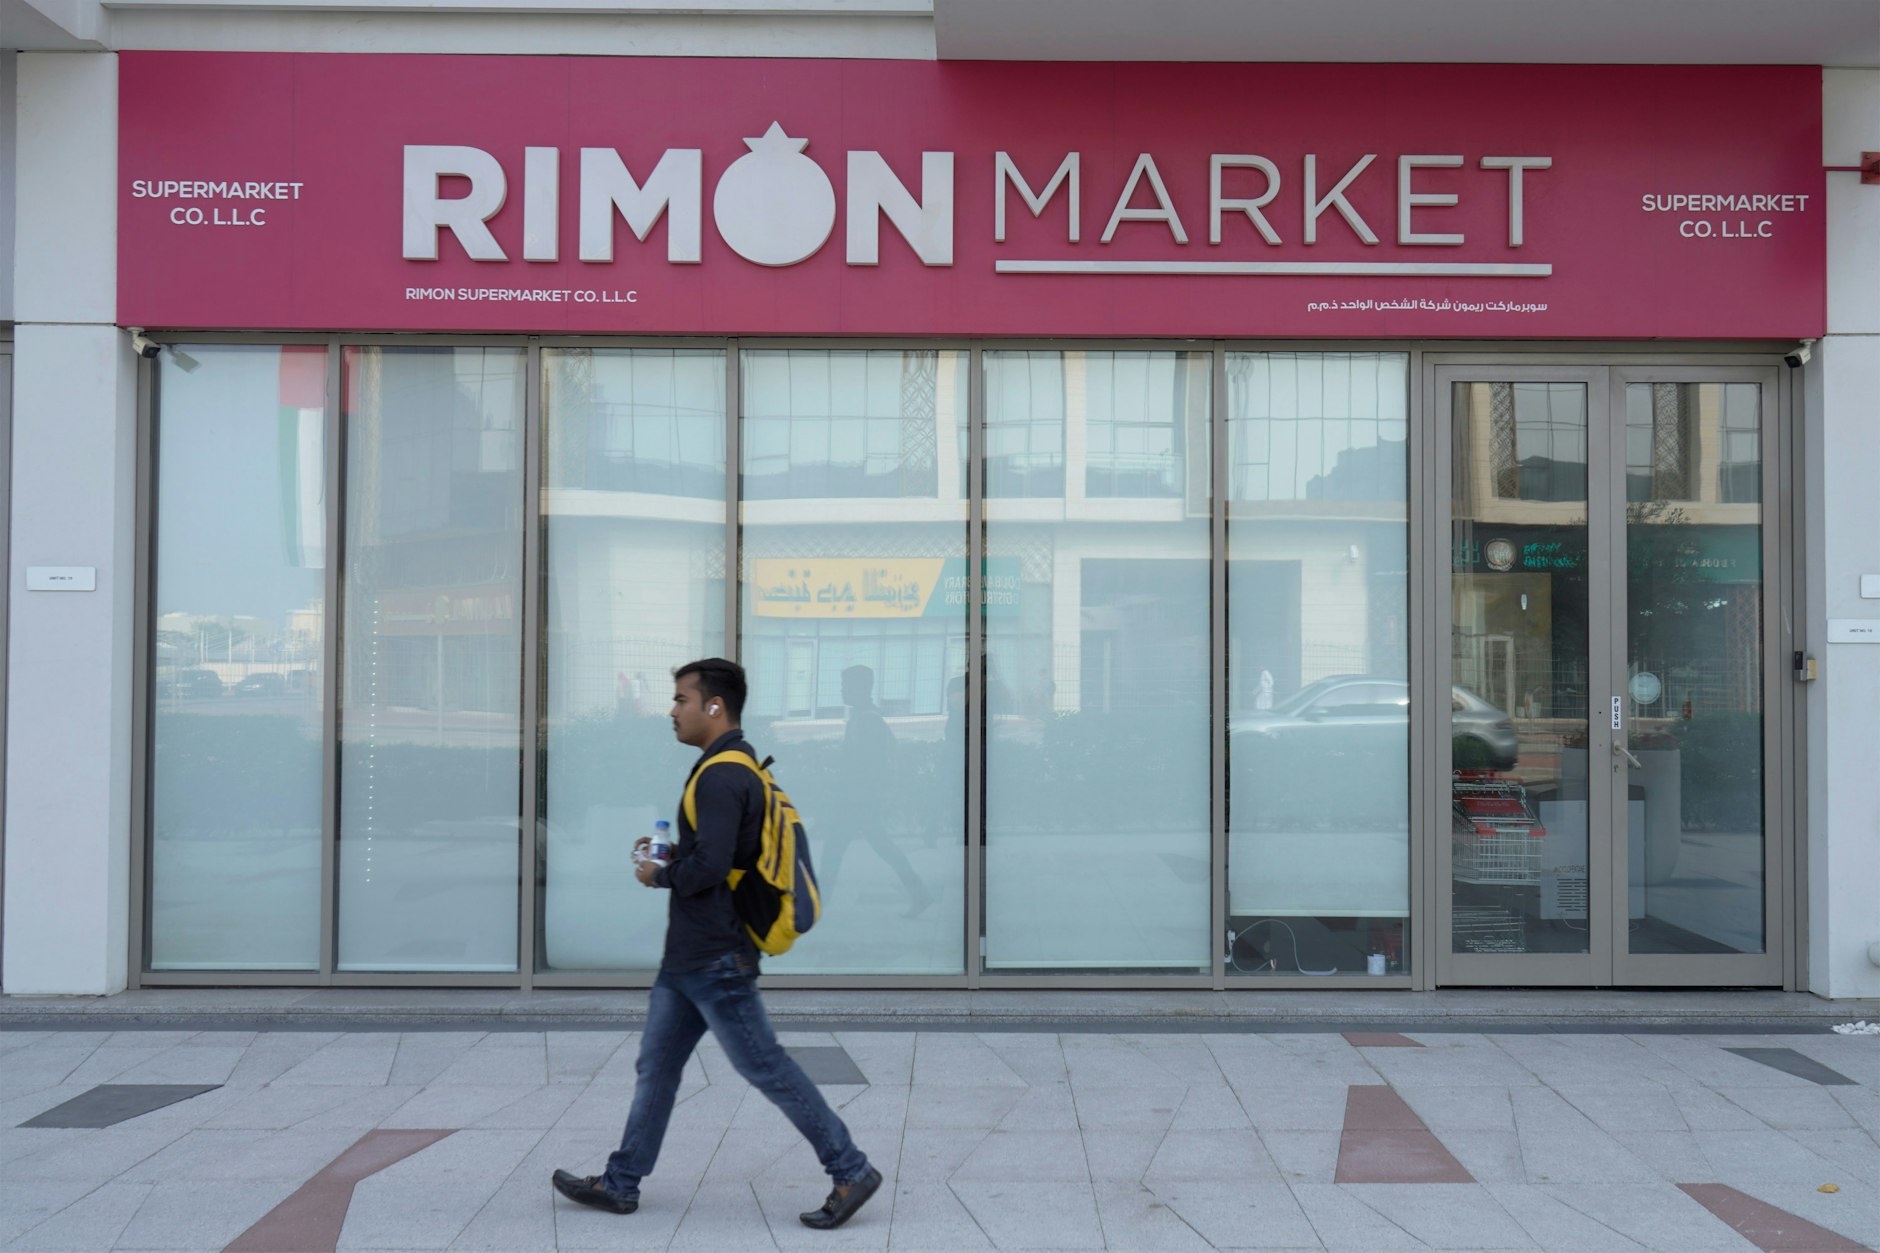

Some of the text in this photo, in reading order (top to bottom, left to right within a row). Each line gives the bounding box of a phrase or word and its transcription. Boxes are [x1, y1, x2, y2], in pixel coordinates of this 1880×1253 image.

[132, 180, 304, 200] SUPERMARKET
[401, 120, 1554, 266] RIMON MARKET
[1641, 194, 1810, 213] SUPERMARKET
[169, 207, 267, 227] CO. L.L.C
[1679, 219, 1773, 238] CO. L.L.C
[405, 287, 638, 304] RIMON SUPERMARKET CO. L.L.C
[1374, 297, 1418, 311] الشخص
[1340, 299, 1373, 311] الواحد
[1419, 297, 1452, 312] شركة
[1452, 299, 1484, 313] ريمون
[1485, 299, 1548, 313] سوبرماركت
